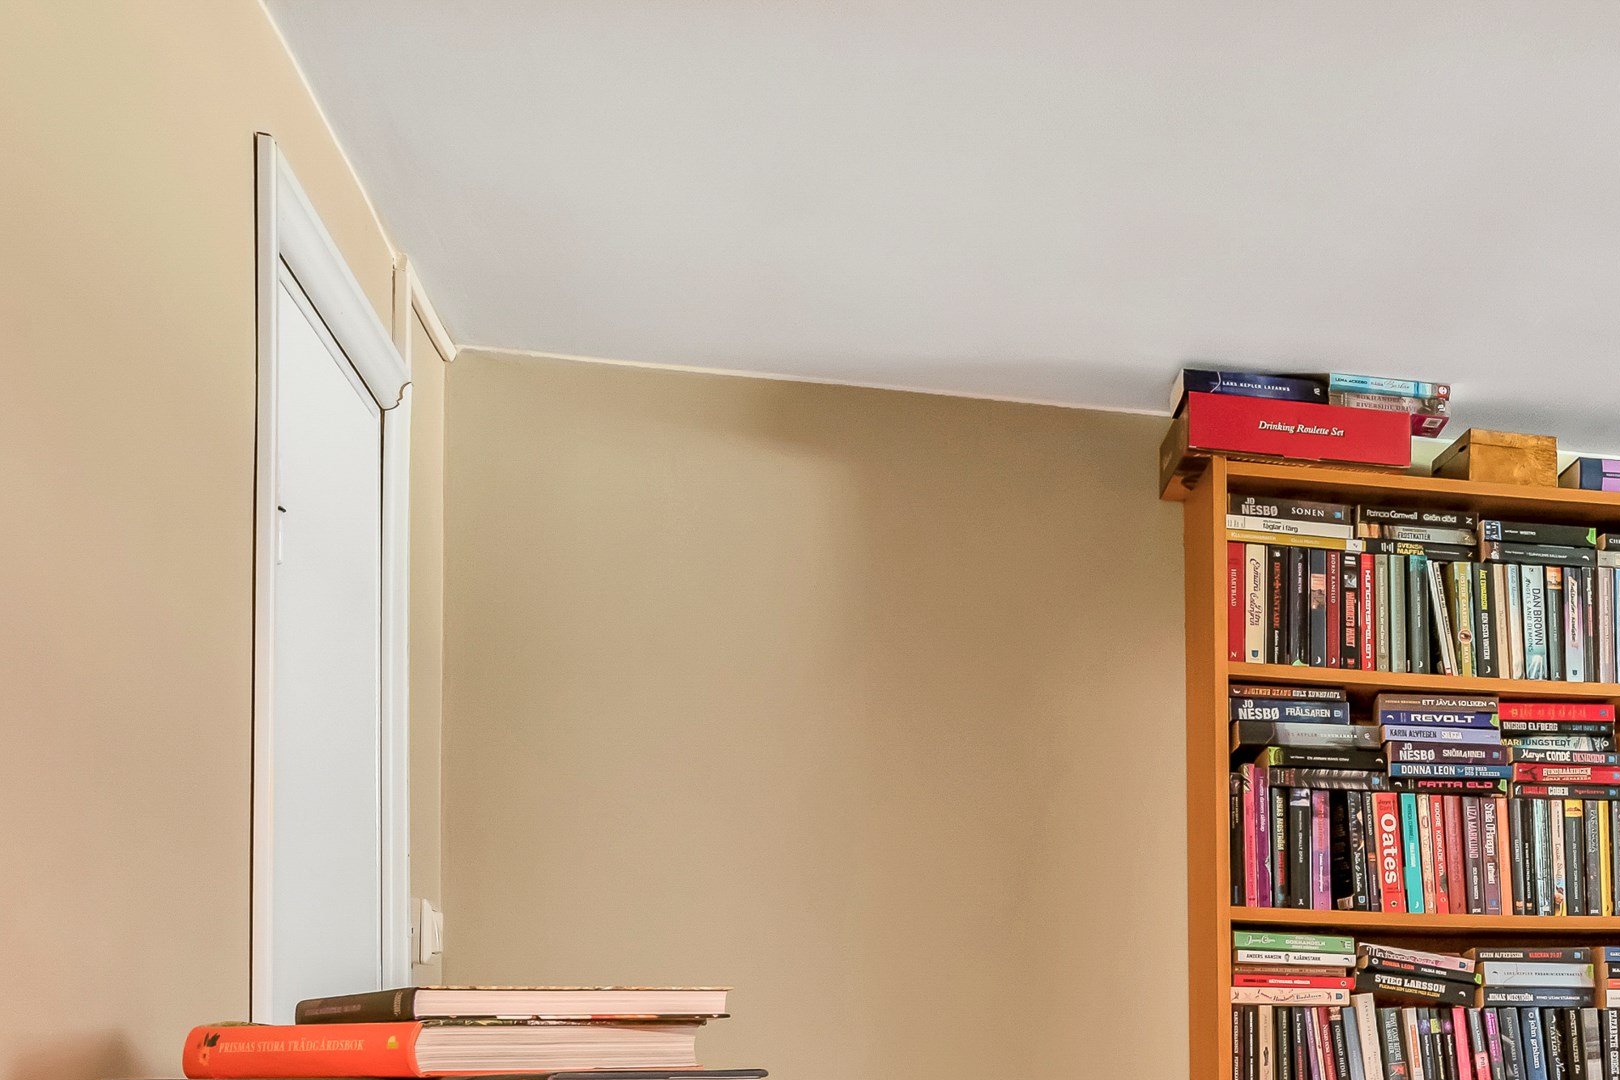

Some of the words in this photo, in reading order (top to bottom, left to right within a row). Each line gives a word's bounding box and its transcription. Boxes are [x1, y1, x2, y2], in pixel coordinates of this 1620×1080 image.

[1258, 421, 1294, 433] Drinking
[1296, 423, 1329, 436] Roulette
[1331, 427, 1344, 436] Set
[1245, 497, 1255, 505] JO
[1241, 503, 1278, 517] NESBØ
[1291, 508, 1325, 518] SONEN
[1366, 508, 1389, 518] Patricia
[1390, 509, 1418, 520] Cornwell
[1423, 513, 1441, 522] Grön
[1442, 514, 1457, 524] död
[1524, 576, 1533, 603] ANGELS
[1532, 588, 1542, 607] DAN
[1533, 610, 1543, 646] BROWN
[1242, 700, 1254, 708] JO
[1239, 707, 1280, 720] NESBØ
[1286, 706, 1331, 718] FRÄLSAREN
[1410, 714, 1475, 723] REVOLT
[1503, 722, 1526, 731] INGRID
[1528, 722, 1558, 731] ELFBERG
[1402, 742, 1412, 750] JO
[1399, 748, 1435, 761] NESBØ
[1442, 749, 1486, 760] SNÖMANNEN
[1401, 764, 1431, 775] DONNA
[1434, 766, 1456, 776] LEON
[1467, 806, 1476, 820] LIZA
[1468, 822, 1478, 859] MARKLUND
[1380, 814, 1398, 884] Oates
[1375, 973, 1402, 987] STIEG
[1404, 977, 1446, 994] LARSSON
[1530, 1020, 1538, 1037] john
[218, 1041, 255, 1053] PRISMAS
[256, 1040, 286, 1053] STORA
[287, 1037, 364, 1052] TRÄDGÅRDSBOK
[1530, 1038, 1540, 1068] grisham
